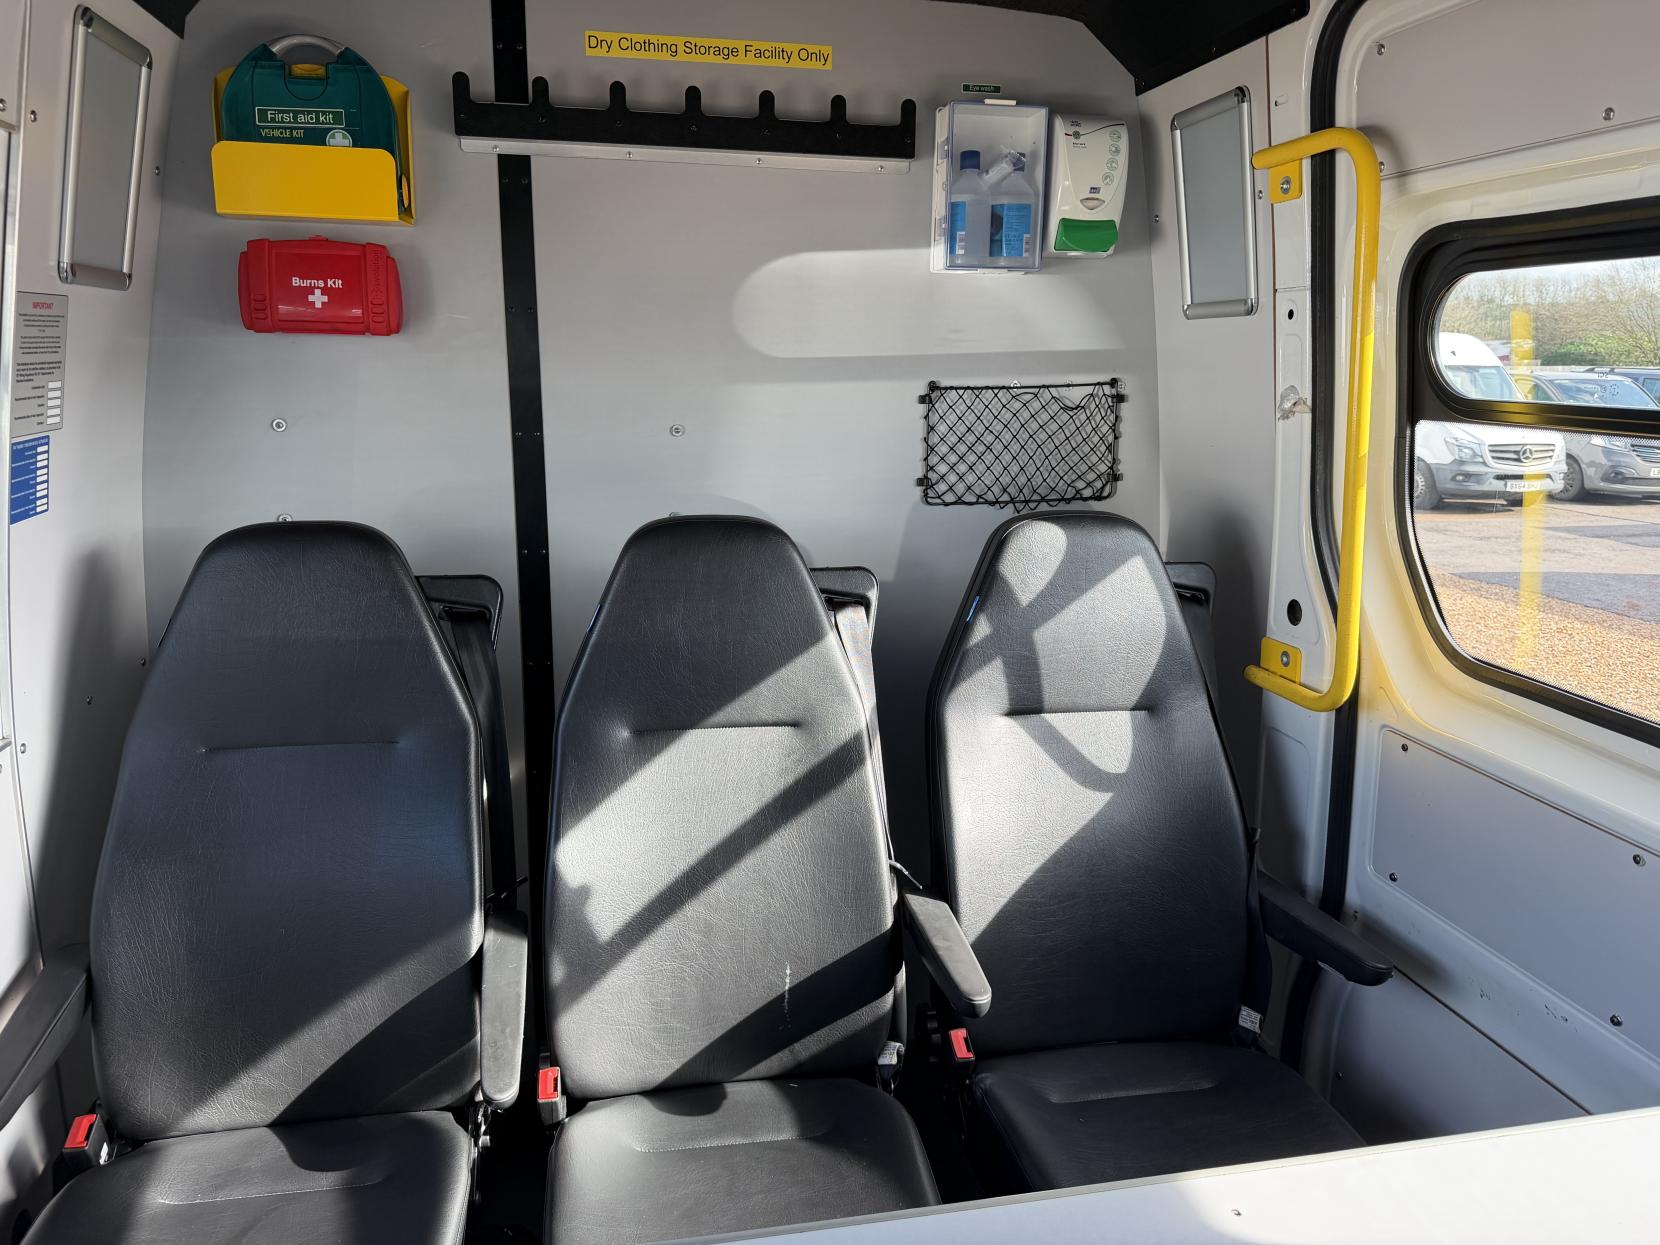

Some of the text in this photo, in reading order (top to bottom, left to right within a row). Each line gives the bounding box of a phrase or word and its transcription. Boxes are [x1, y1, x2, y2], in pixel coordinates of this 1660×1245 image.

[588, 35, 829, 66] Dry Clothing Storage Facility Only
[267, 110, 334, 124] First aid kit
[260, 128, 305, 138] VEHICLE KIT
[292, 277, 343, 289] Burns Kit
